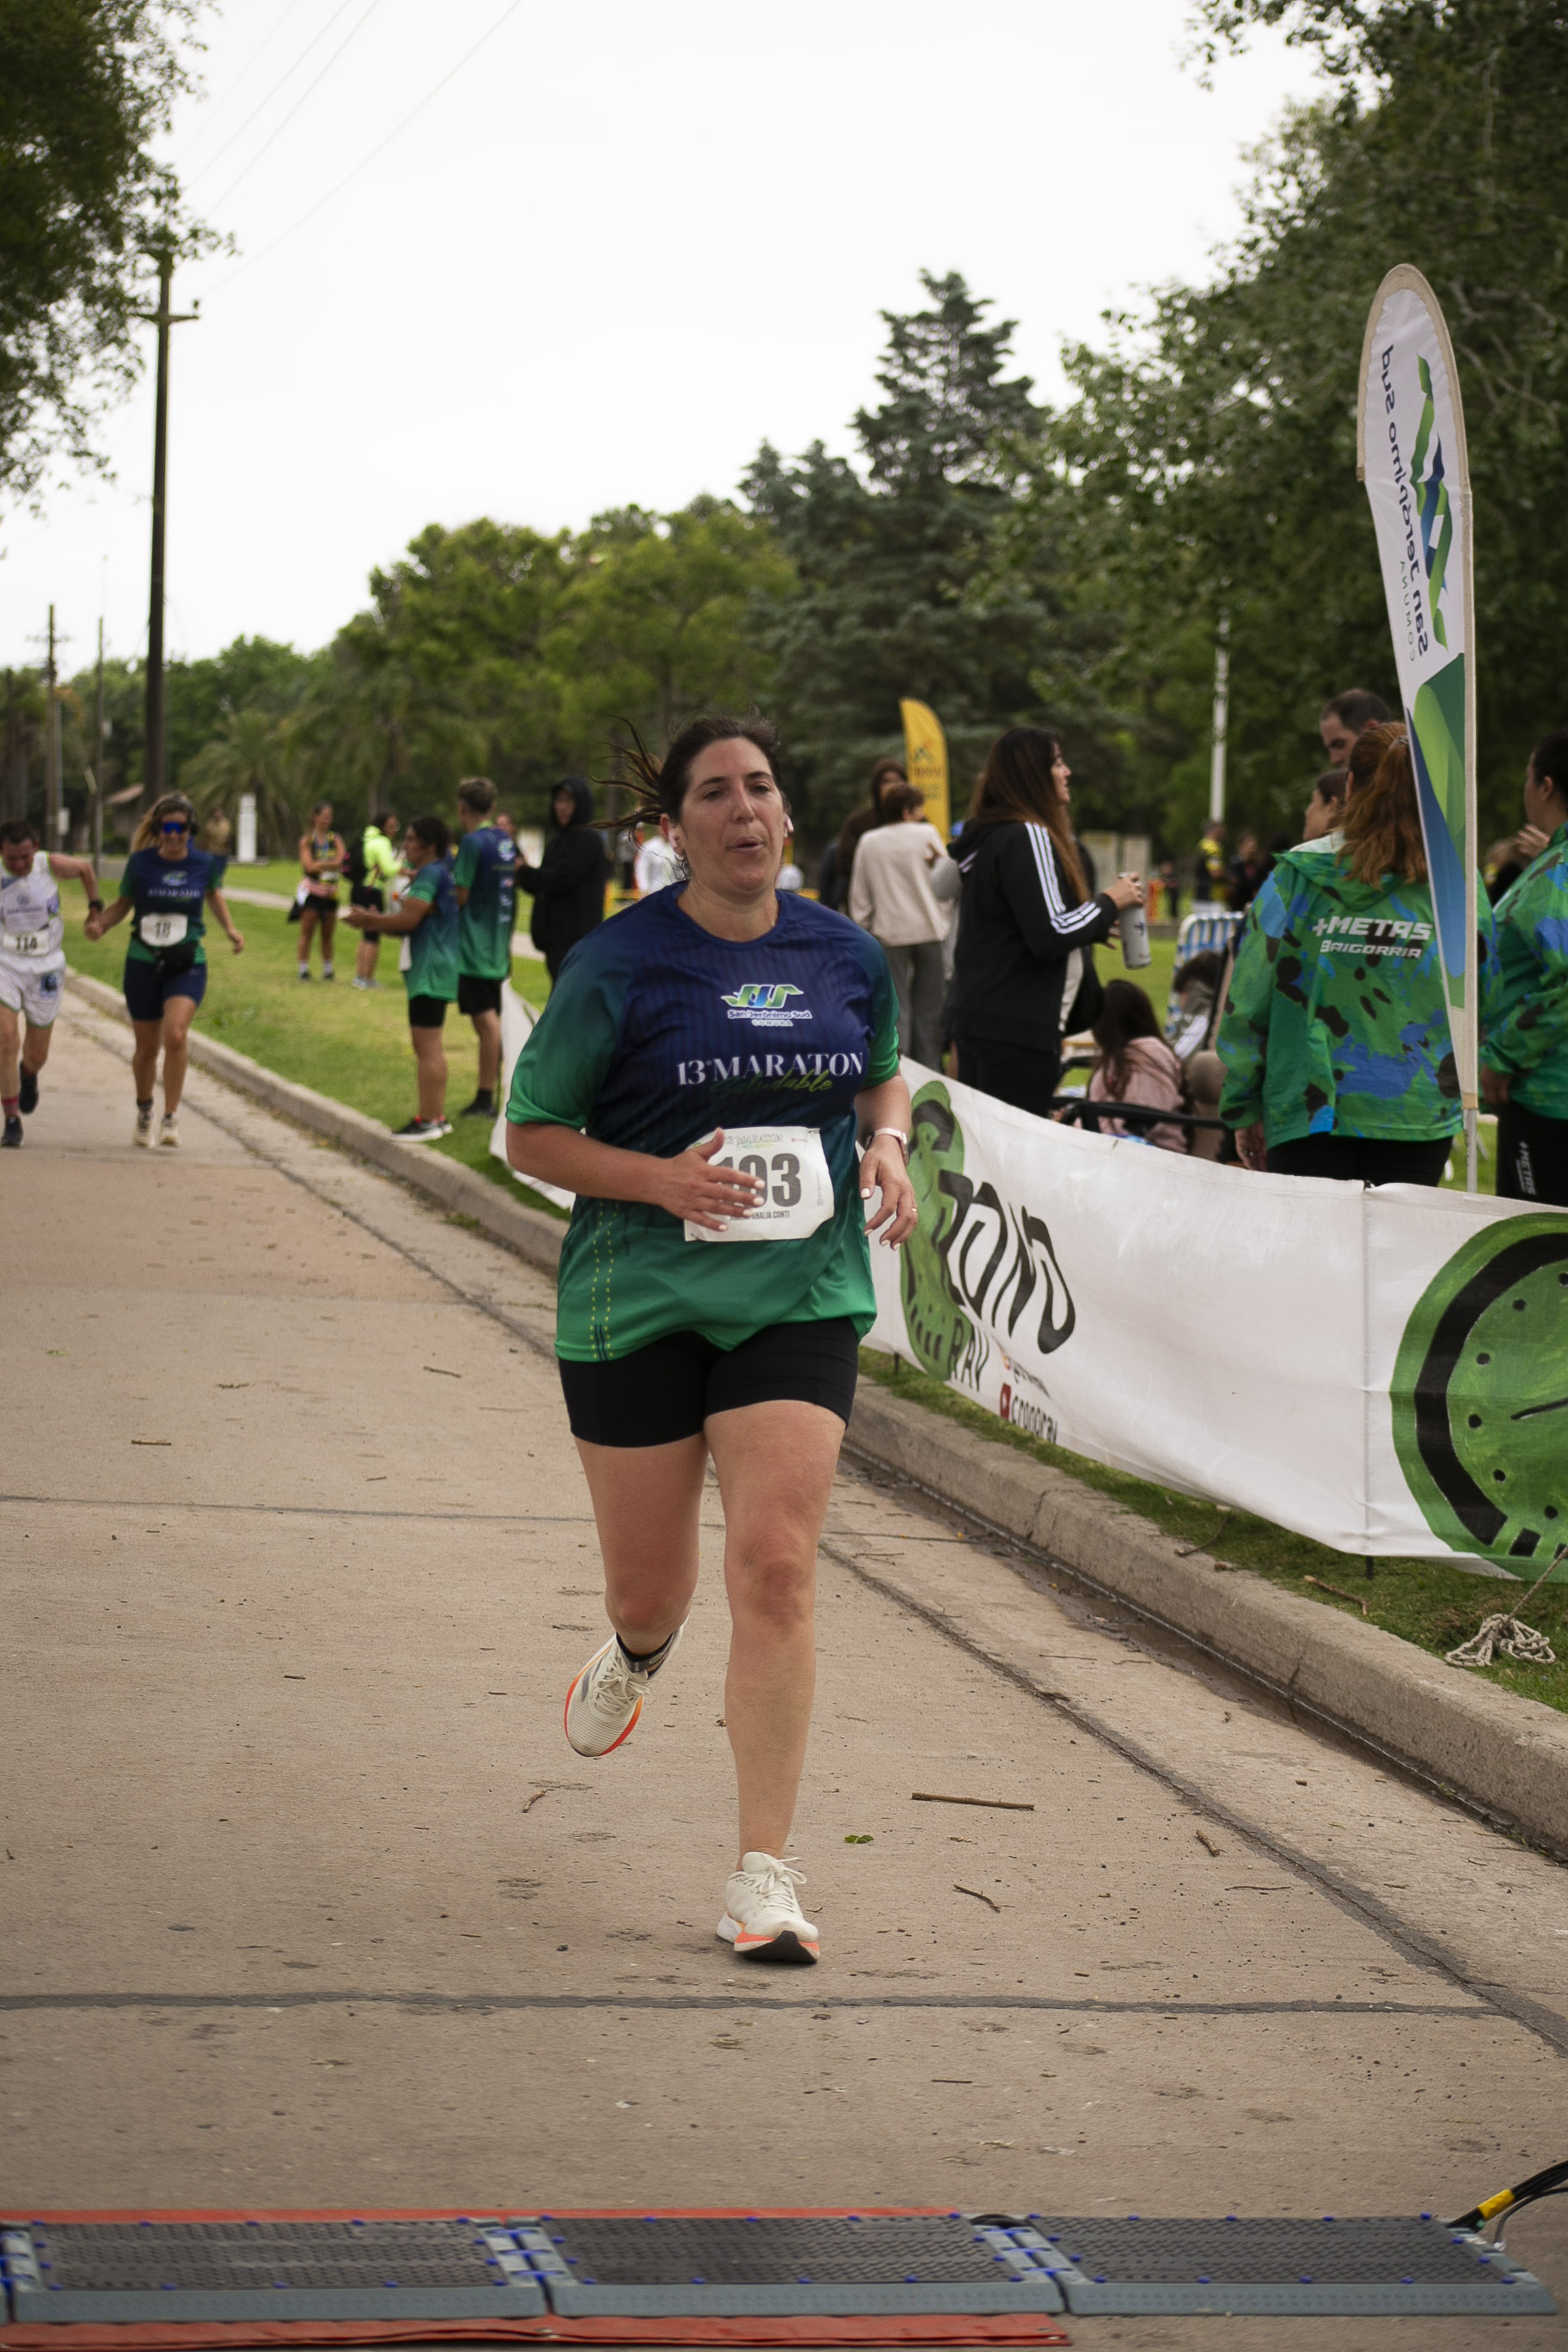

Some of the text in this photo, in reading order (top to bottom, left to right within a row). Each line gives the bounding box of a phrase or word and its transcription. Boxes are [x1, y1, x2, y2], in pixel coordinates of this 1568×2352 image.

[728, 1010, 747, 1019] San
[793, 1009, 812, 1019] Sud
[713, 1051, 863, 1081] MARATON
